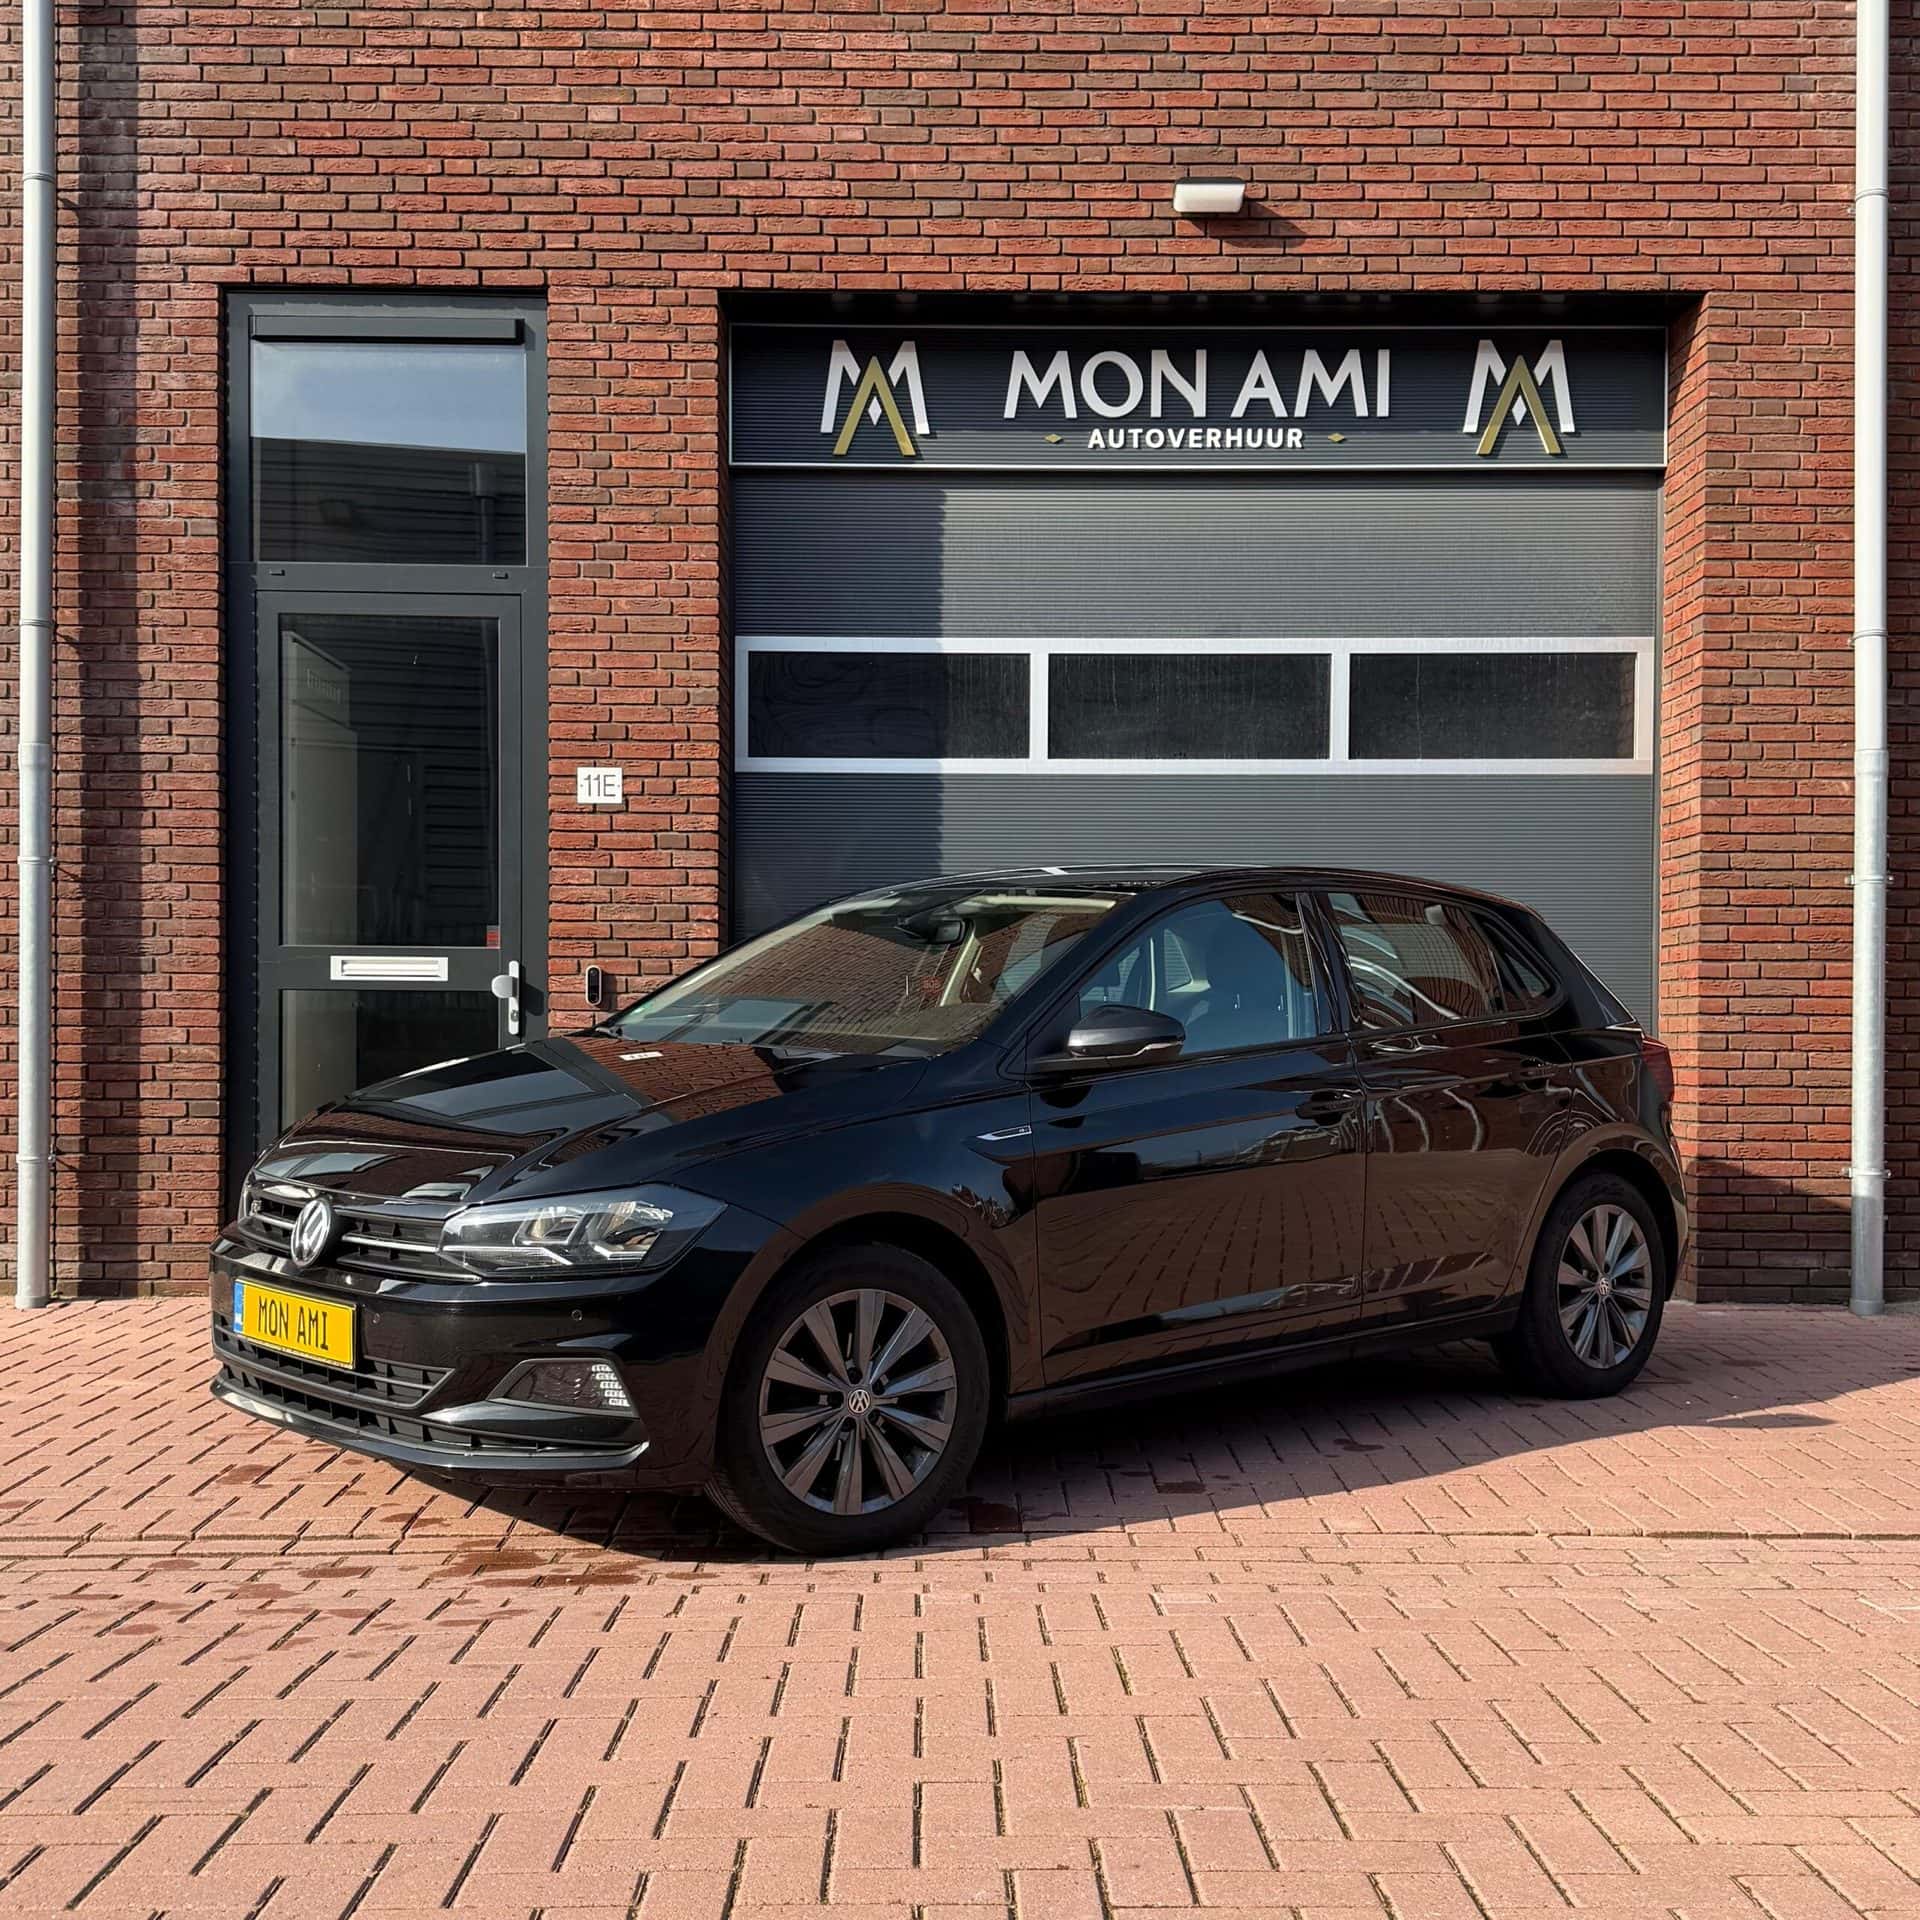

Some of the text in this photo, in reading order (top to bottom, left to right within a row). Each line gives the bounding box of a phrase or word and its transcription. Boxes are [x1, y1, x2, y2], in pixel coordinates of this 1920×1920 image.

[1003, 349, 1390, 418] MON AMI
[1088, 428, 1302, 449] AUTOVERHUUR
[584, 774, 616, 797] 11E
[258, 1297, 329, 1351] MON AMI
